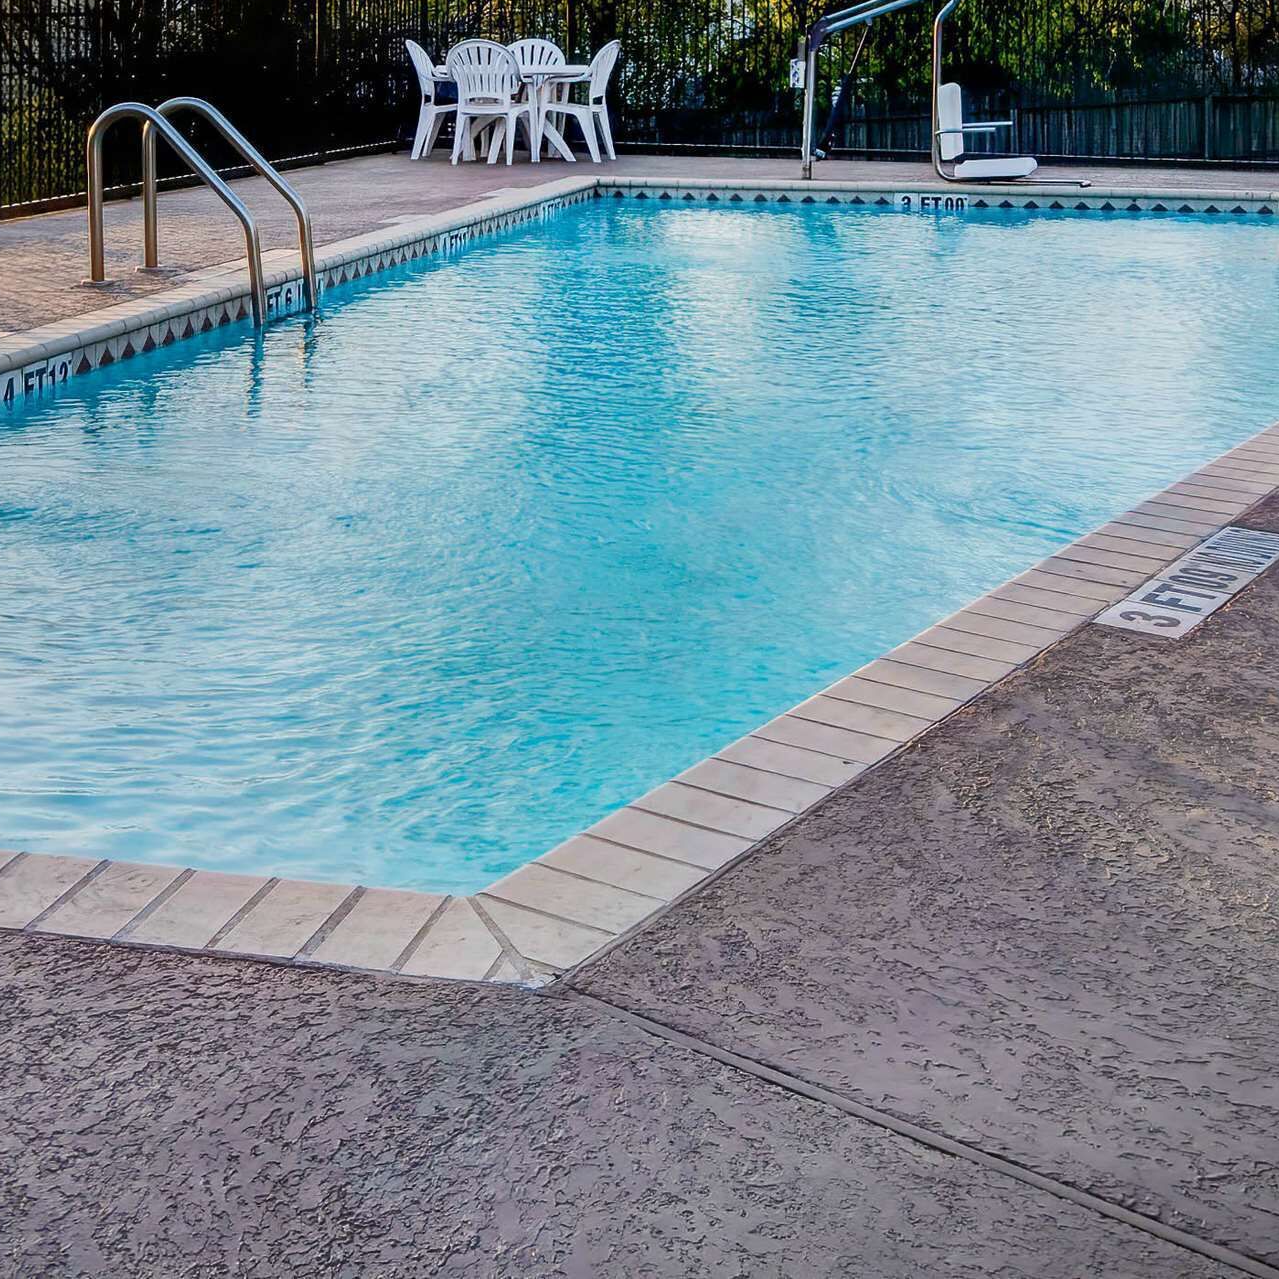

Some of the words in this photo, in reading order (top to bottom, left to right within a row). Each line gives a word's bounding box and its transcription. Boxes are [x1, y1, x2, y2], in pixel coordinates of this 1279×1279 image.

[921, 196, 942, 210] FT
[24, 366, 48, 394] FT
[1140, 583, 1218, 613] FT
[1119, 609, 1182, 628] 3
